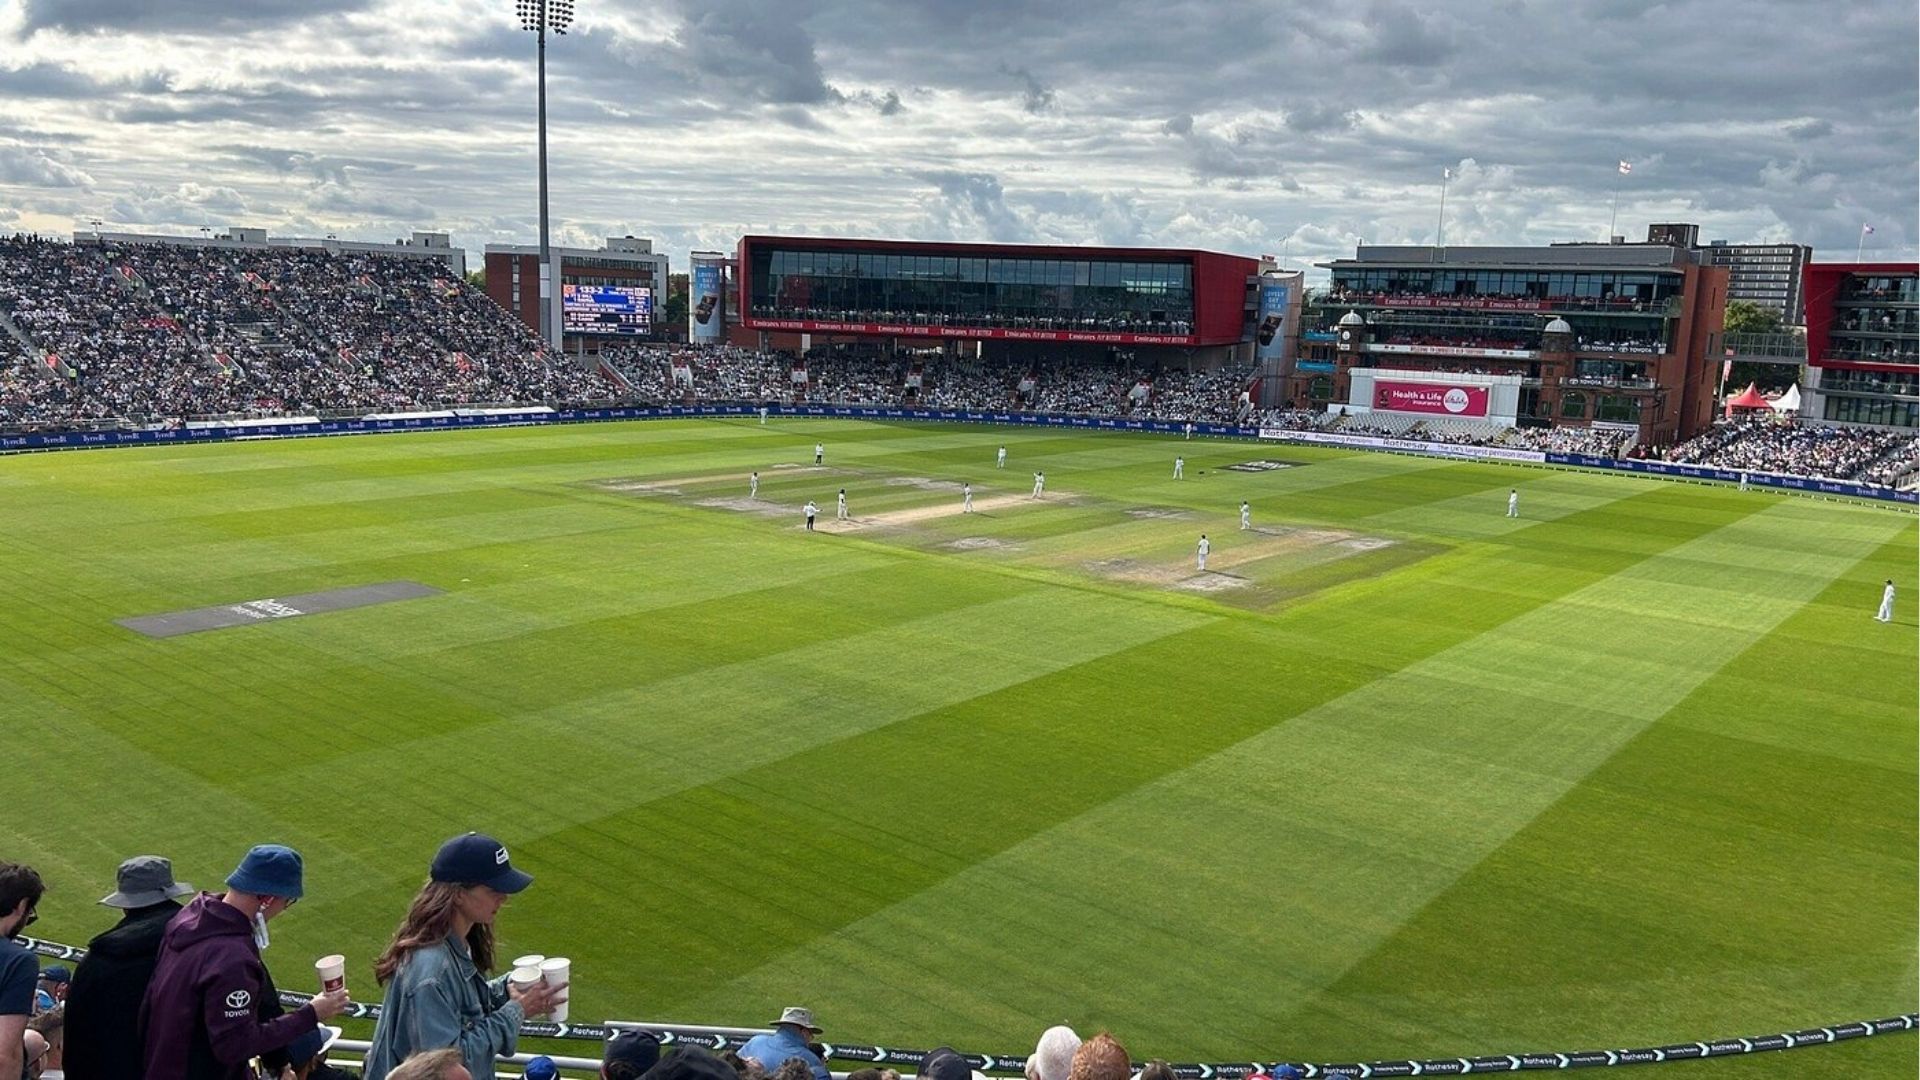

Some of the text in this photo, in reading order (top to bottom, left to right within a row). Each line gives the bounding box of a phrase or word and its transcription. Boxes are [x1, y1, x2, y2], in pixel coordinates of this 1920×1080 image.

[878, 325, 904, 333] Emirates
[941, 328, 967, 336] Emirates
[1004, 330, 1032, 338] Emirates
[1068, 333, 1096, 341] Emirates
[1134, 335, 1162, 343] Emirates
[1392, 390, 1418, 399] Health
[1427, 393, 1442, 401] Life
[1263, 429, 1307, 440] Rothesay
[1383, 438, 1429, 450] Rothesay
[1465, 446, 1487, 456] largest
[1488, 448, 1515, 458] pension
[678, 1035, 713, 1046] Rothesay
